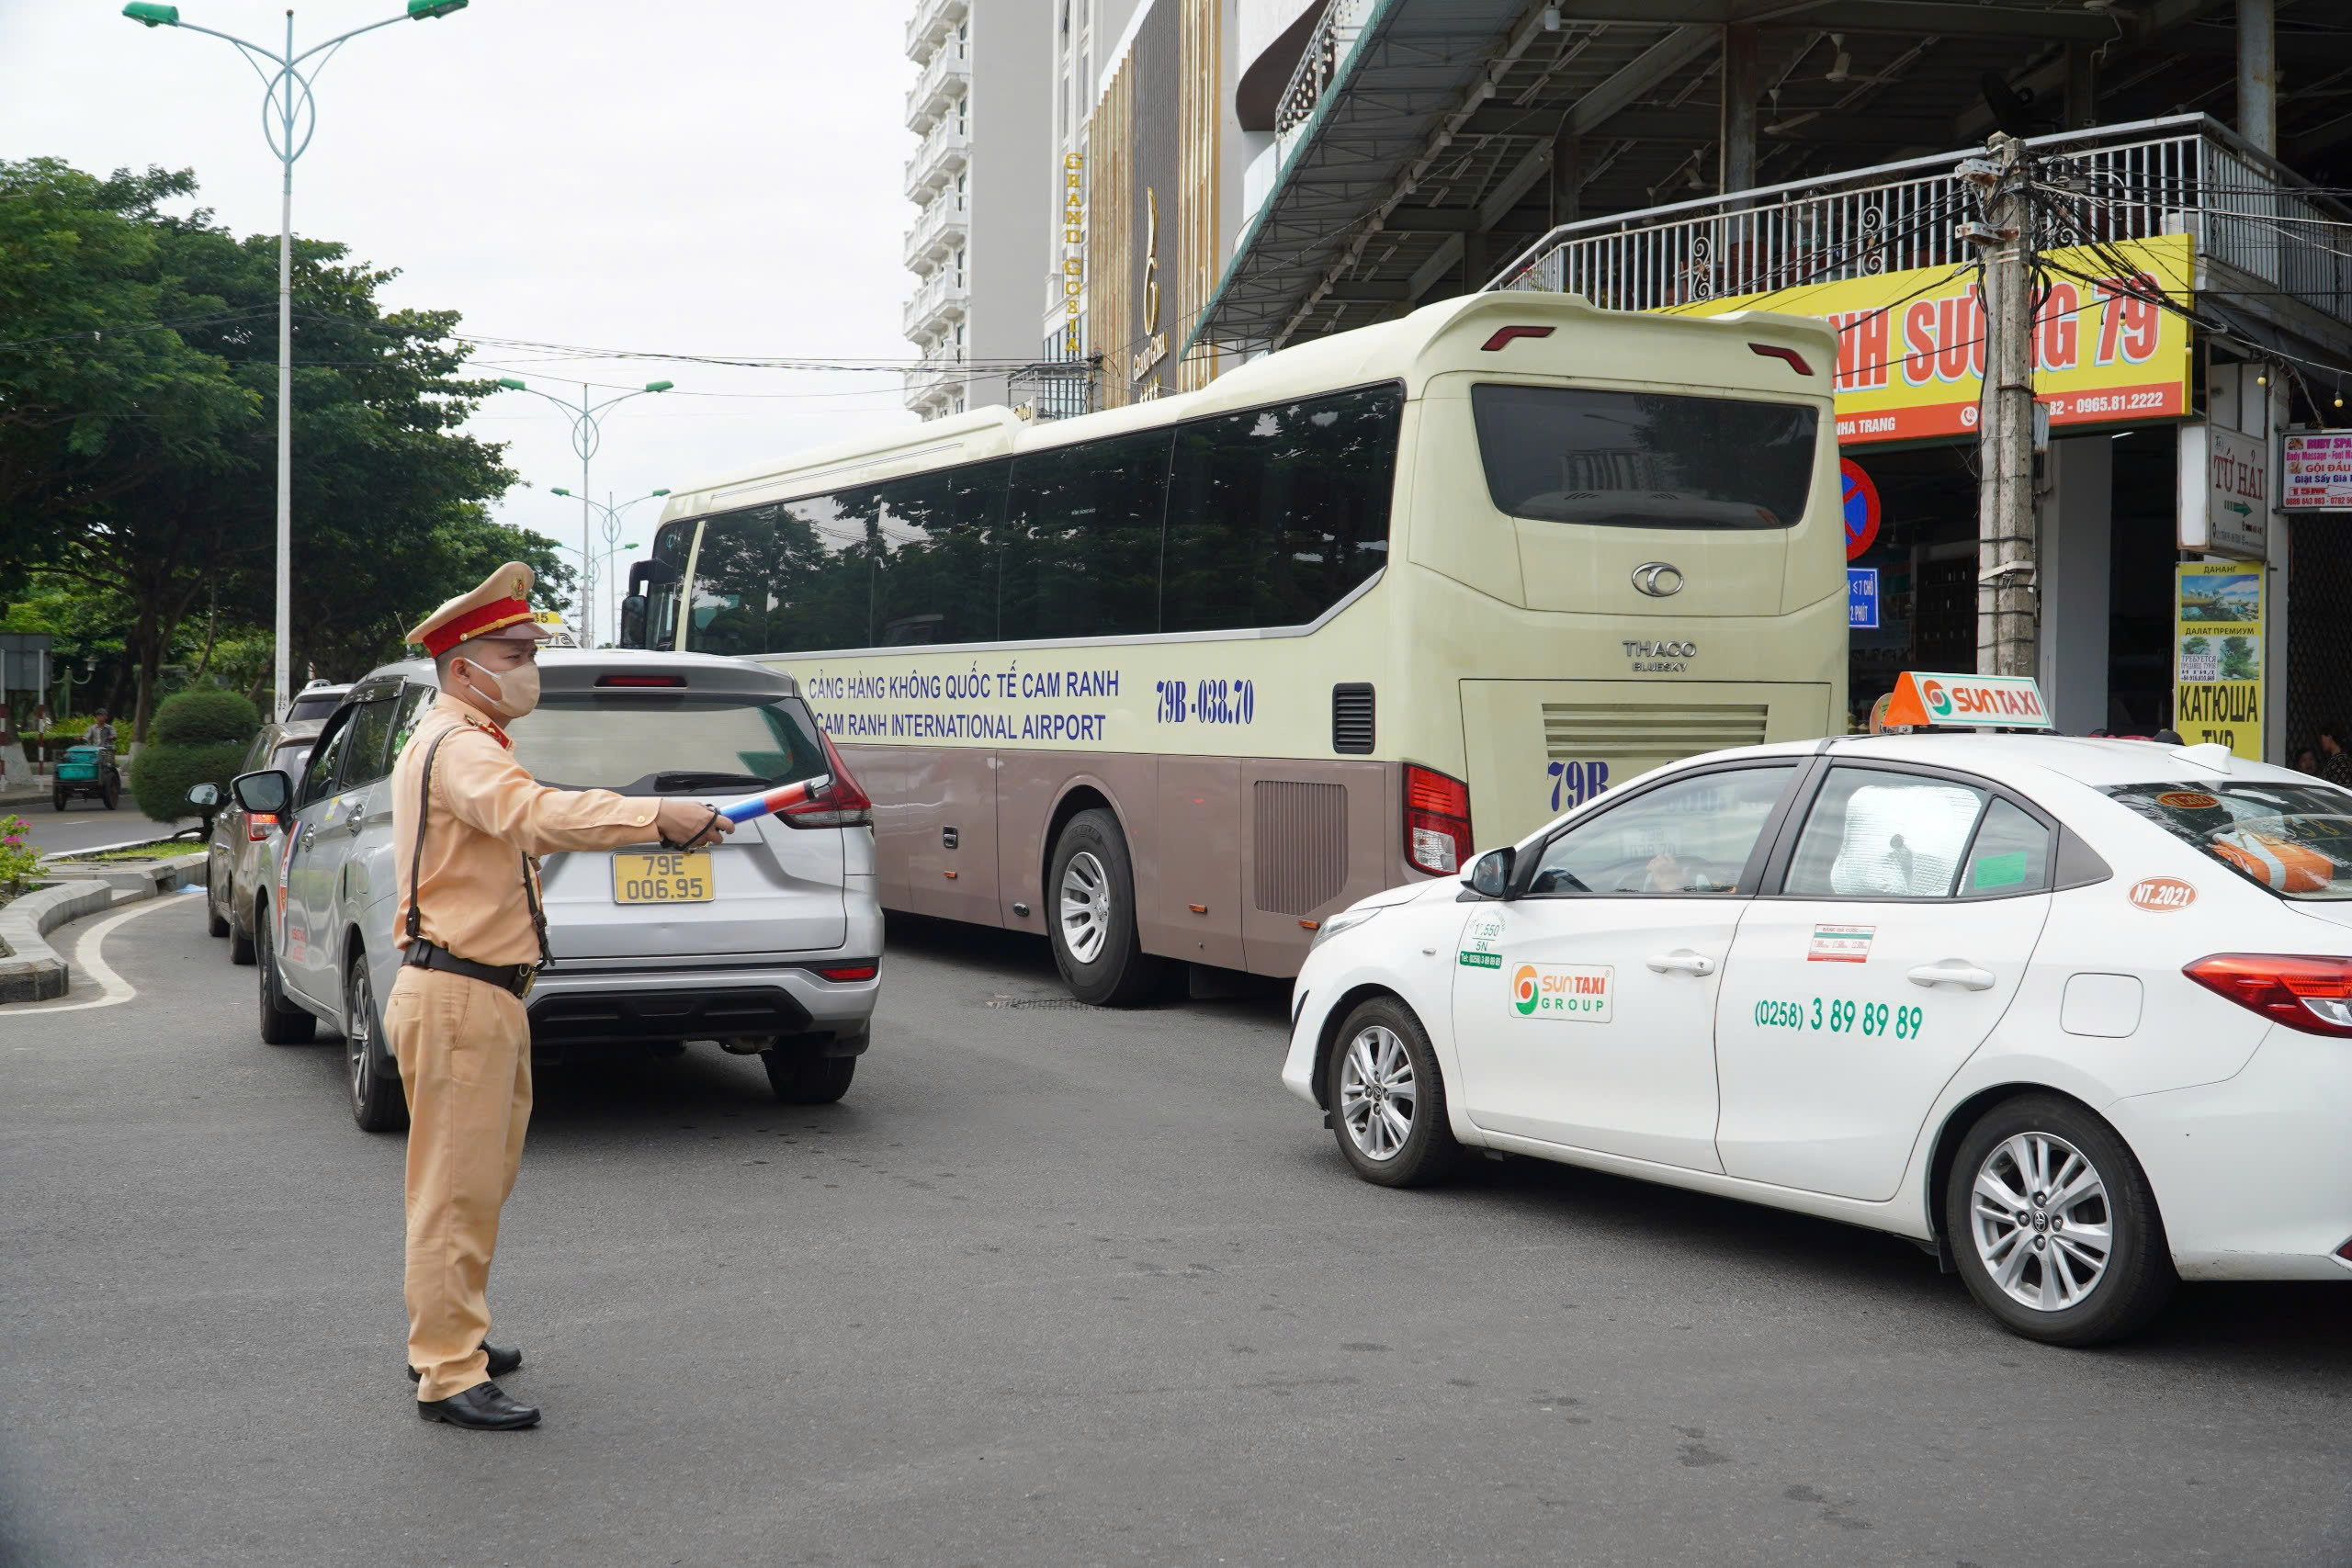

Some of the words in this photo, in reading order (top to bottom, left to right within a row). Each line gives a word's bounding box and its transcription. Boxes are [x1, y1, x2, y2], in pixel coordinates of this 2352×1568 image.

[1066, 152, 1082, 243] GRAND
[1064, 257, 1082, 352] GOSIA
[2095, 274, 2161, 366] 79
[2076, 391, 2163, 413] 0965.81.2222
[1859, 417, 1896, 434] TRANG
[2237, 449, 2264, 501] HẢI
[2204, 566, 2237, 574] ДАНАНГ
[2185, 627, 2212, 636] ДАЛАТ
[1623, 640, 1696, 657] THACO
[1633, 662, 1688, 672] BLUESKY
[808, 669, 843, 699] CẢNG
[848, 670, 885, 699] HÀNG
[889, 669, 941, 699] KHÔNG
[945, 660, 990, 700] QUỐC
[997, 660, 1017, 698] TẾ
[1023, 671, 1060, 699] CAM
[1067, 671, 1119, 697] RANH
[1952, 687, 1999, 714] SUN
[1996, 690, 2041, 716] TAXI
[2180, 685, 2258, 722] КАТЮША
[816, 712, 843, 735] CAM
[849, 714, 887, 736] RANH
[891, 714, 1017, 739] INTERNATIONAL
[1022, 715, 1106, 740] AIRPORT
[1547, 761, 1610, 812] 79B
[642, 855, 684, 876] 79E
[627, 878, 703, 899] 006.95
[2133, 884, 2191, 906] NT.2021
[1476, 941, 1488, 951] 5N
[1542, 975, 1573, 993] SUN
[1575, 976, 1605, 995] TAXI
[1541, 998, 1604, 1012] GROUP
[1755, 999, 1804, 1032] (0258)
[1811, 997, 1823, 1030] 3
[1830, 998, 1856, 1032] 89
[1862, 1002, 1889, 1036] 89
[1895, 1005, 1923, 1040] 89
